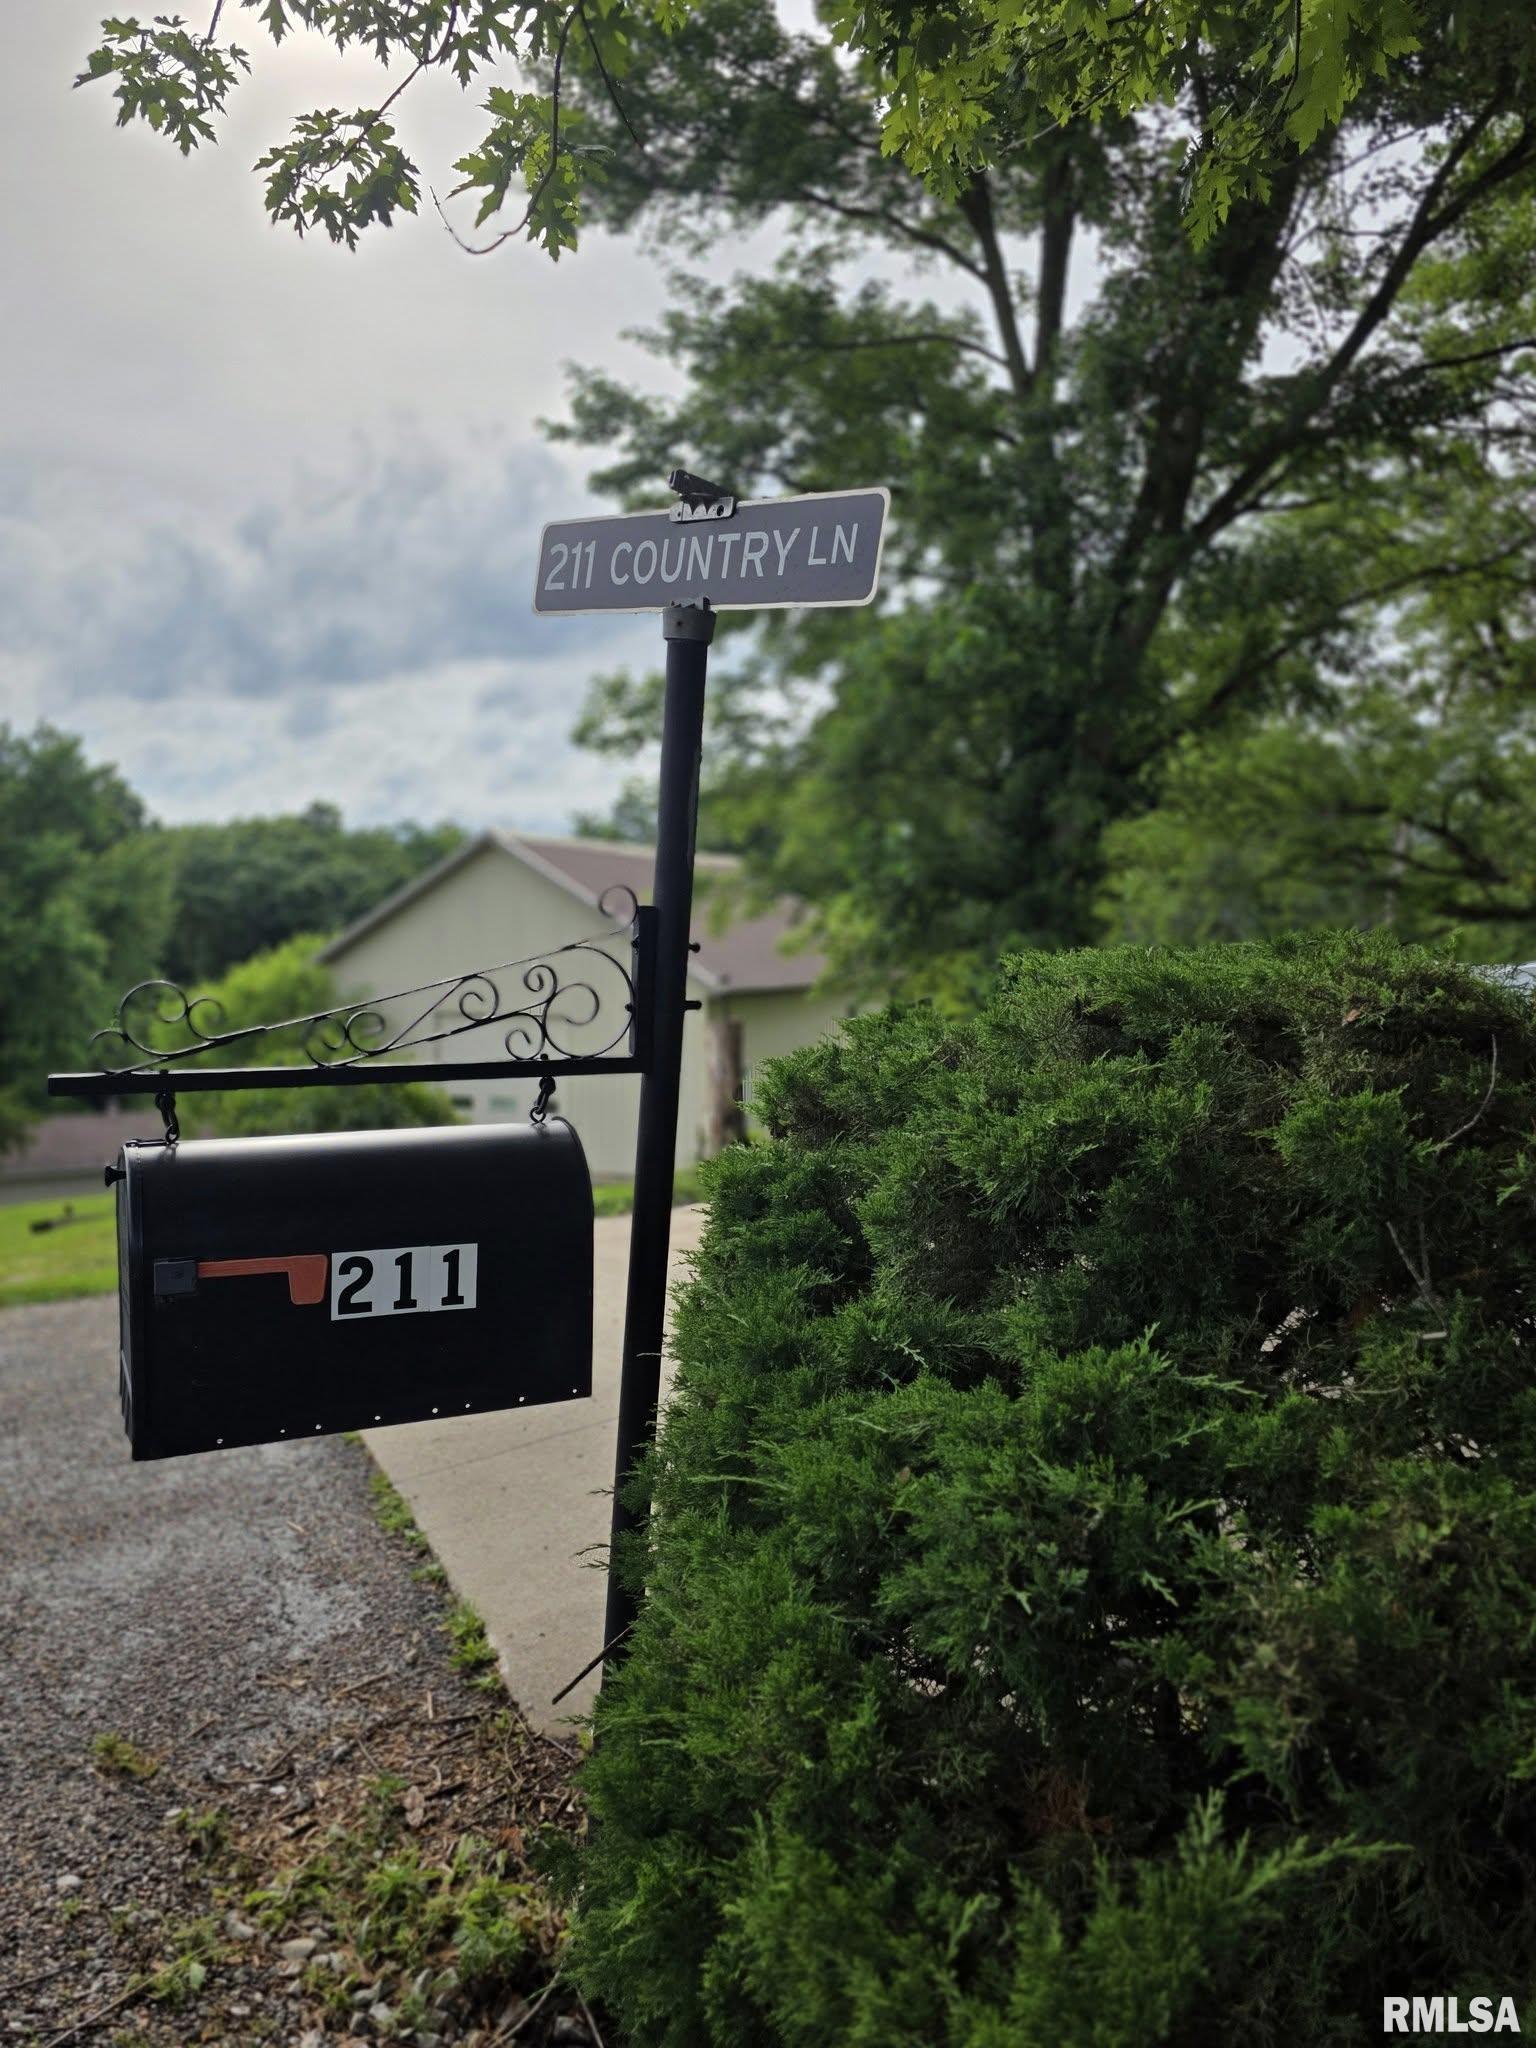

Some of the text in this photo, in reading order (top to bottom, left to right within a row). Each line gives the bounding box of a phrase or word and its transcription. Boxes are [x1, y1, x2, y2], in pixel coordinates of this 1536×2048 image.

[544, 523, 859, 591] 211 COUNTRY LN
[337, 1248, 465, 1315] 211
